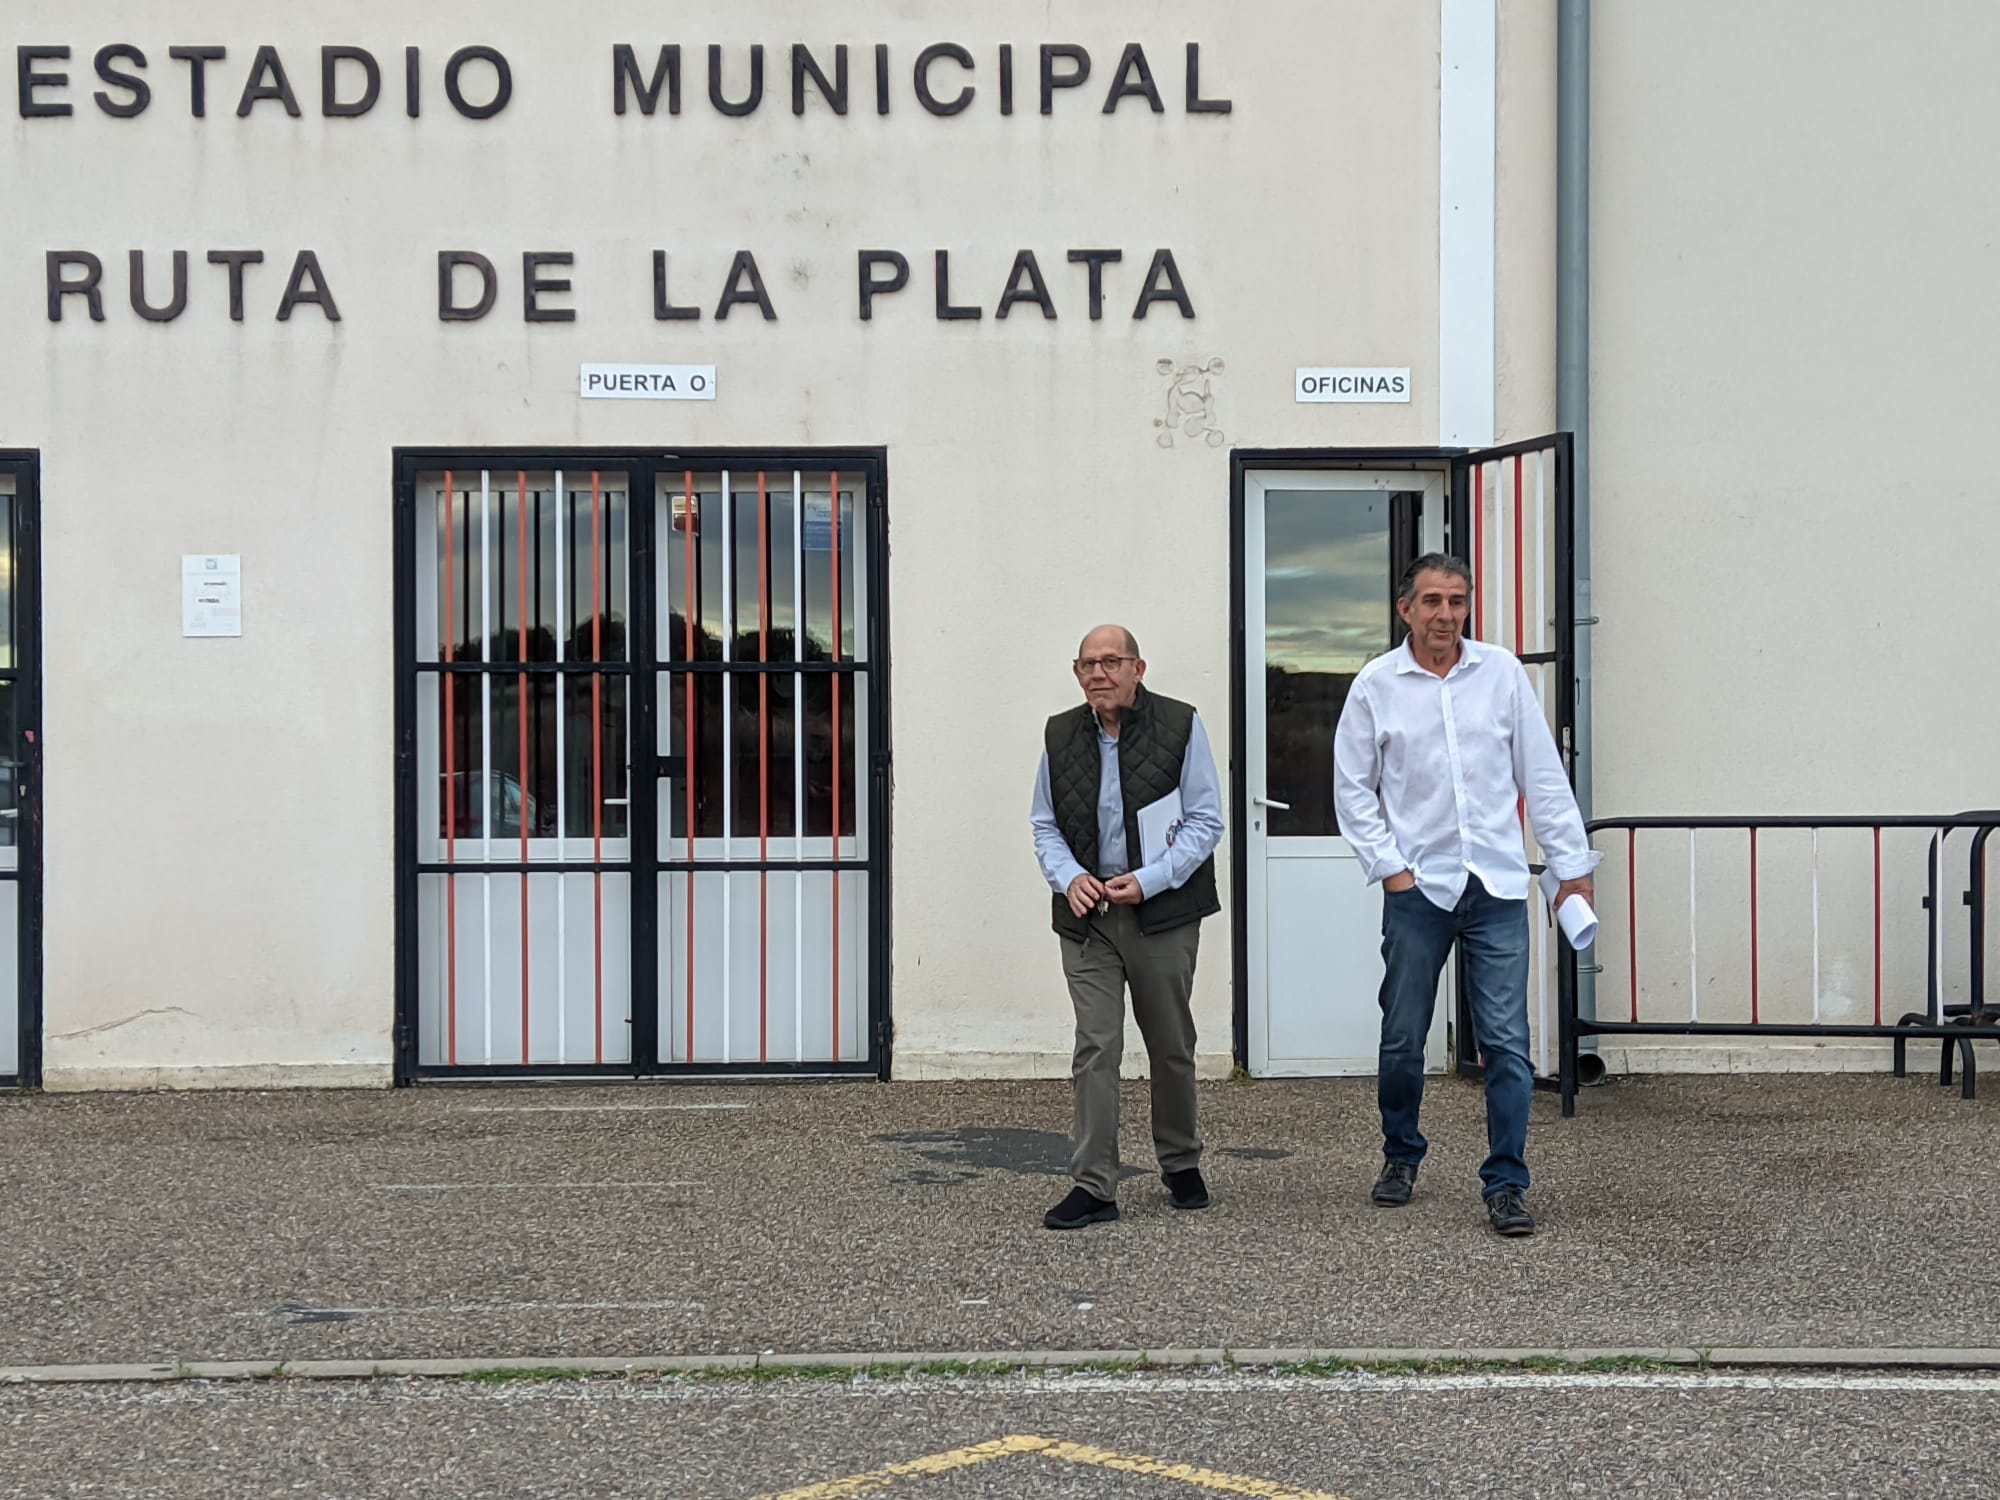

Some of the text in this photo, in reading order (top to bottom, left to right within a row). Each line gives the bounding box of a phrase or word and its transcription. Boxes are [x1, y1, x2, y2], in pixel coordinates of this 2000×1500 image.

[18, 42, 1232, 120] ESTADIO MUNICIPAL
[47, 249, 1196, 323] RUTA DE LA PLATA
[588, 373, 677, 392] PUERTA
[1301, 376, 1405, 394] OFICINAS
